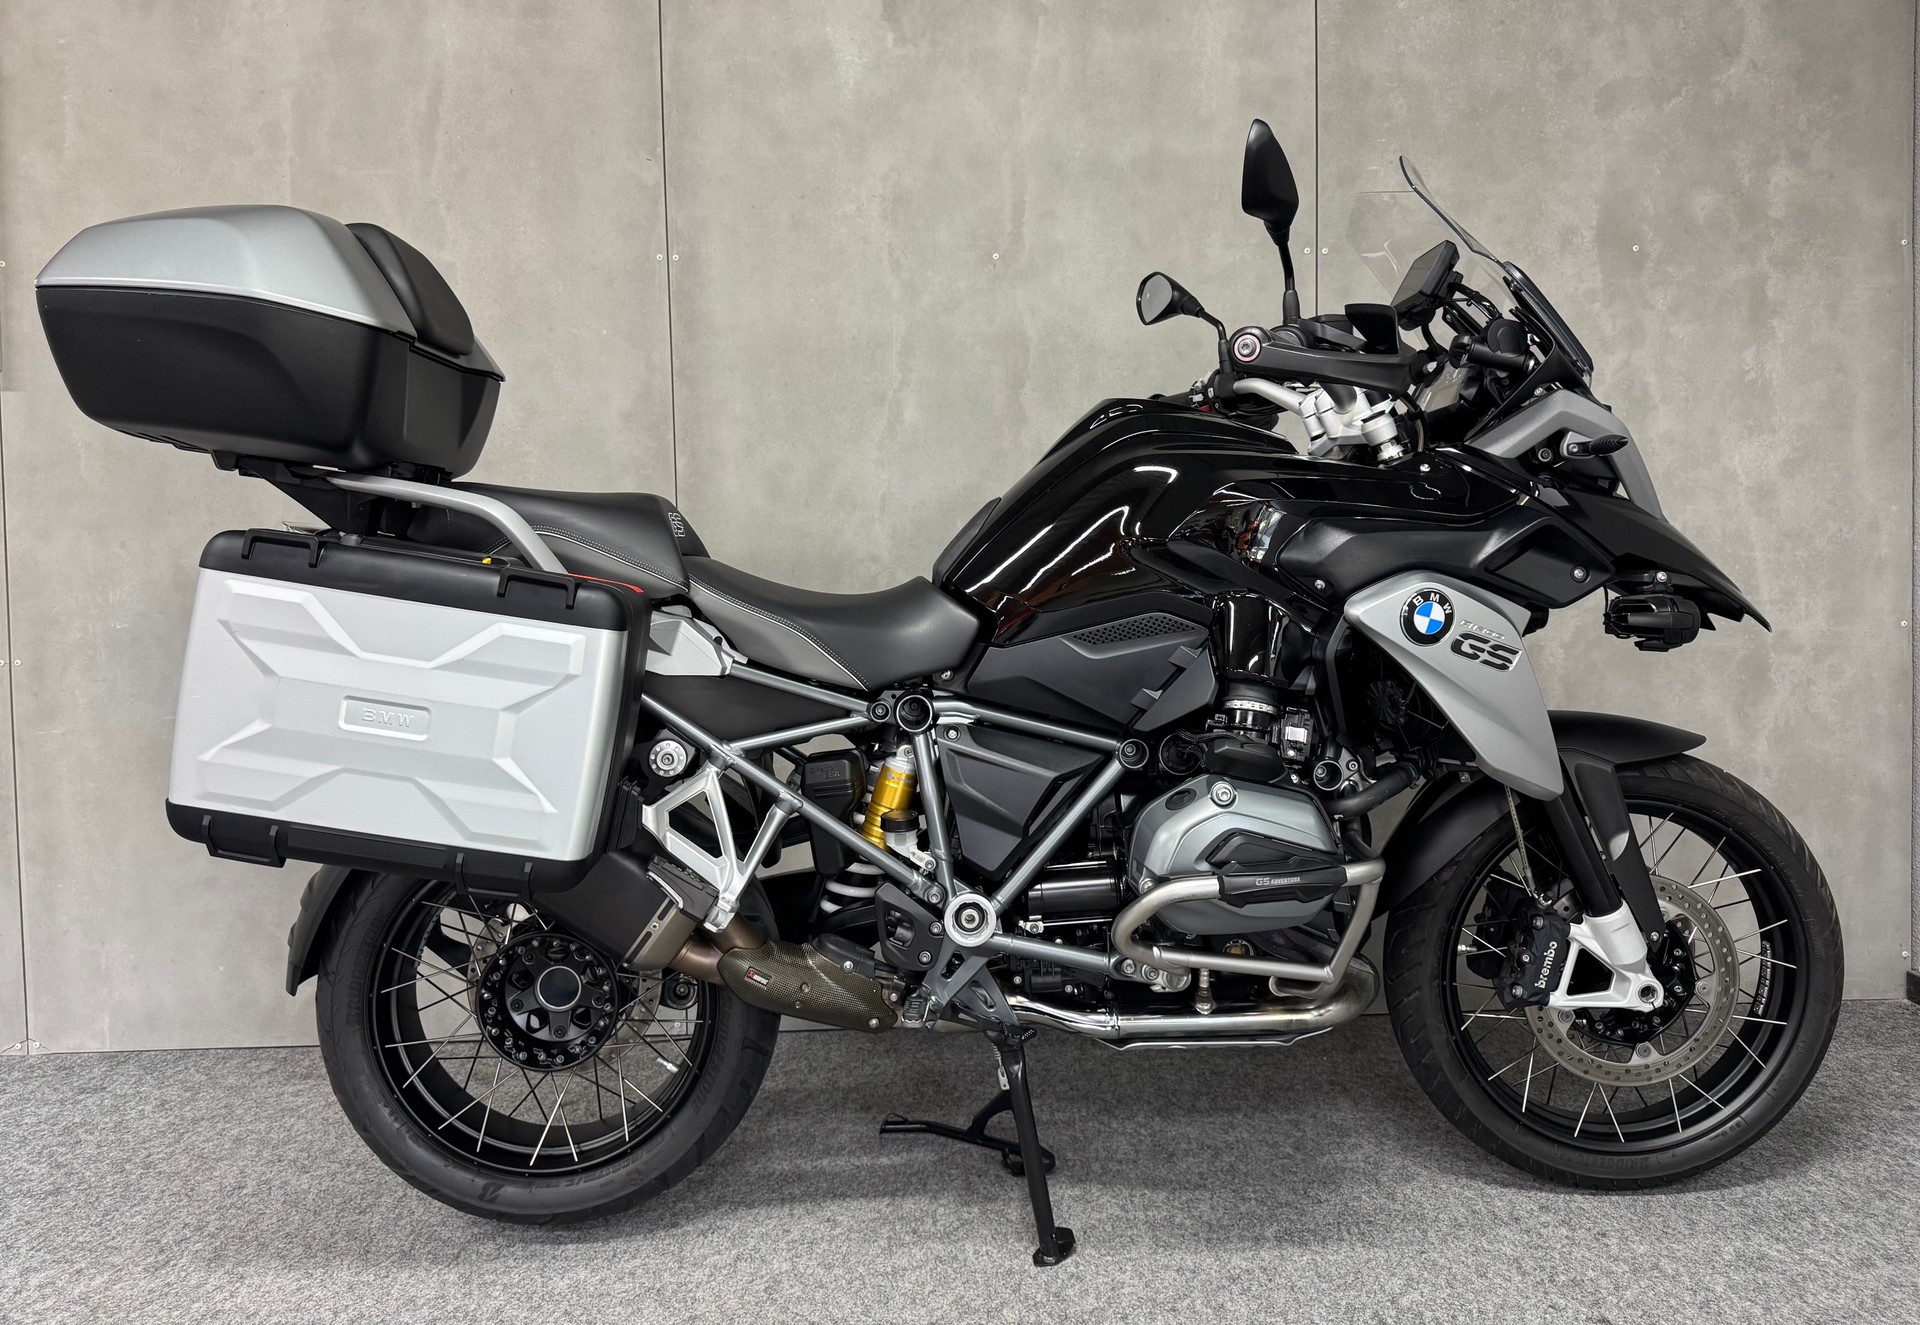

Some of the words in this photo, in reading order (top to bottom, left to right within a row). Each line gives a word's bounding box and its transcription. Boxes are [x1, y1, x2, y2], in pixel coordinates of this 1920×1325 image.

[1412, 592, 1453, 615] BMW
[1450, 631, 1522, 672] GS
[361, 708, 415, 728] BMW
[1255, 877, 1271, 887] GS
[1271, 876, 1301, 885] ADVENTURE
[1534, 941, 1558, 989] brembo
